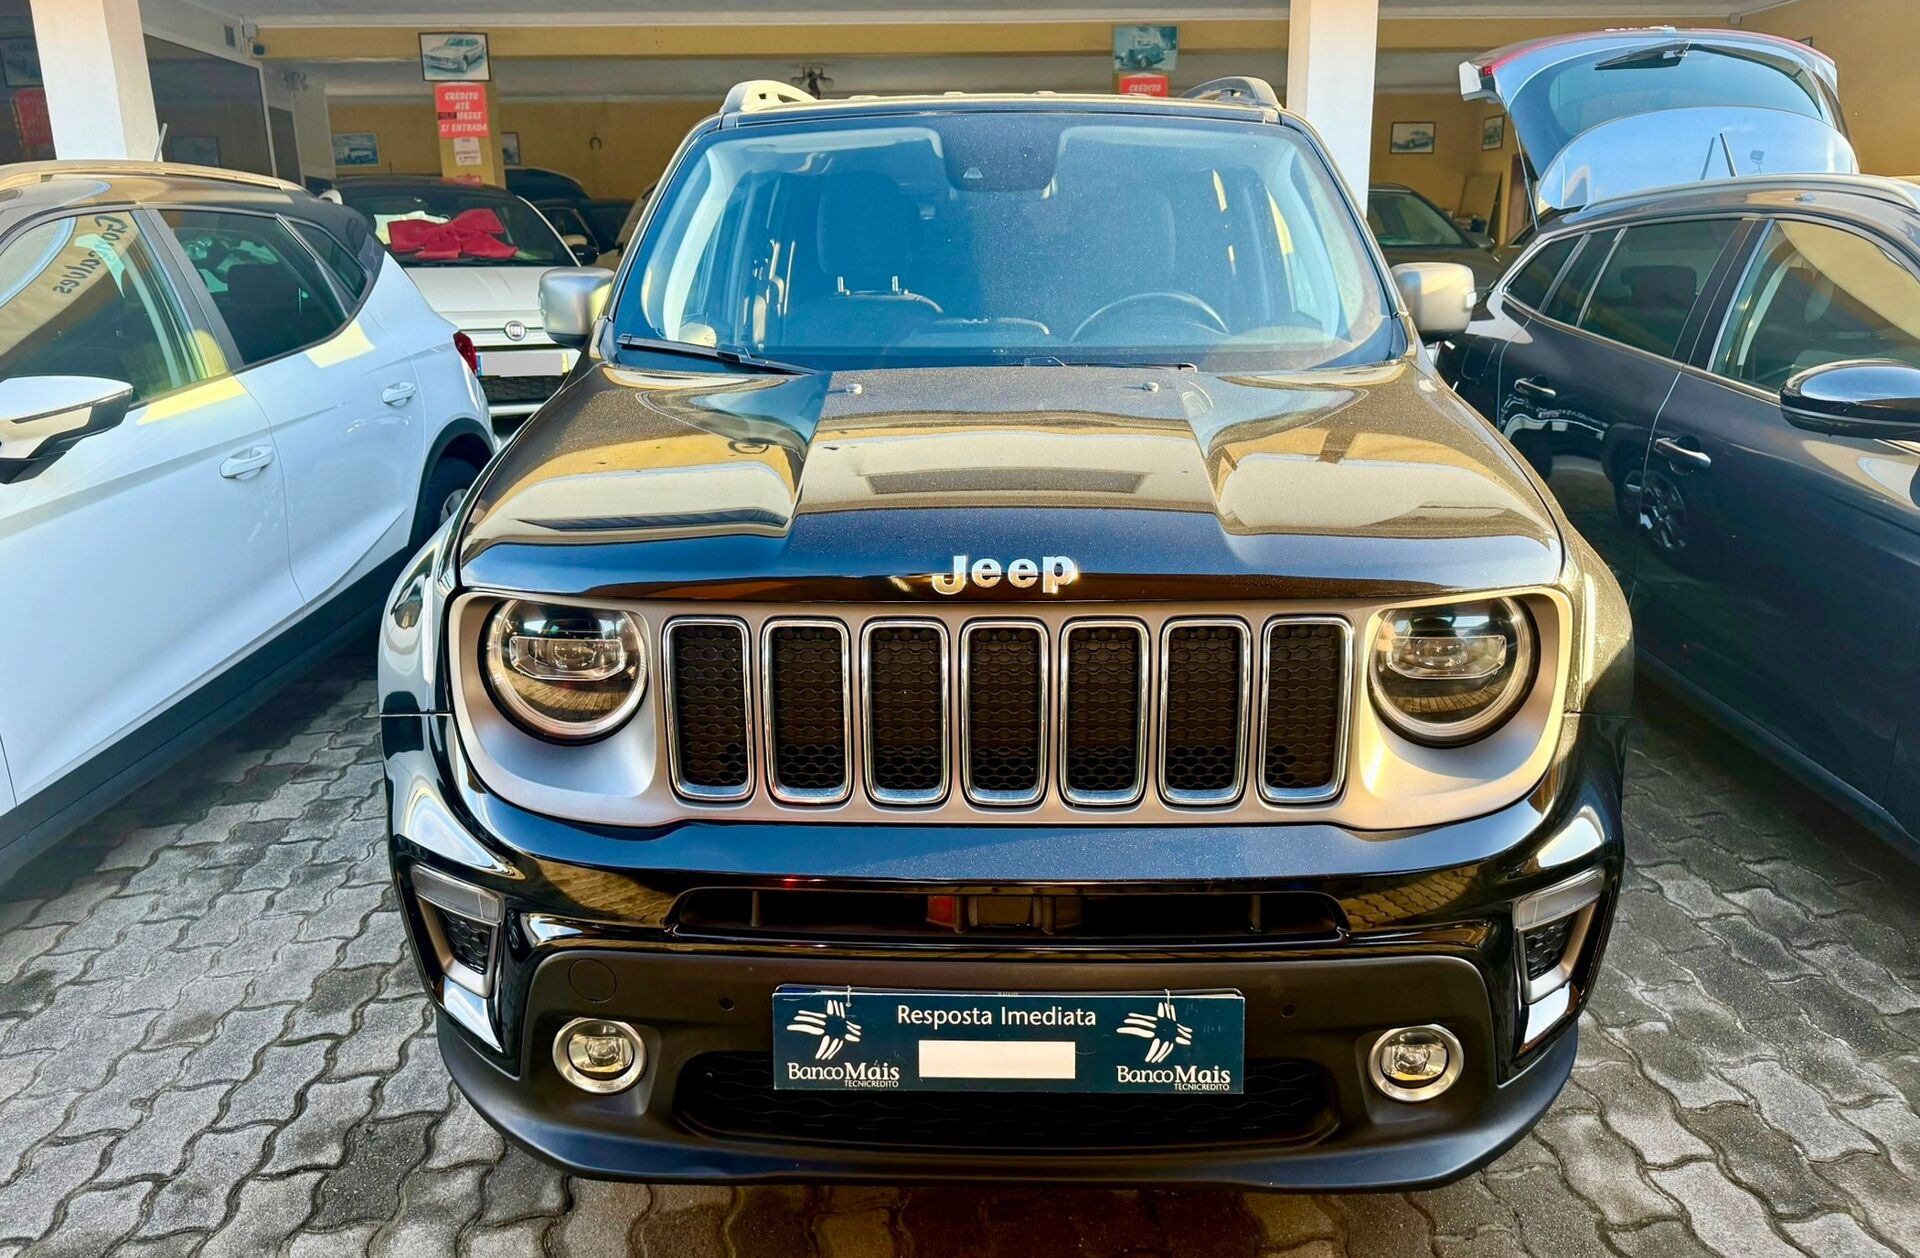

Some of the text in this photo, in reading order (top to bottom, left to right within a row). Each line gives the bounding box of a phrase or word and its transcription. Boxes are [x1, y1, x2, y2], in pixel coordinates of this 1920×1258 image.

[444, 91, 479, 100] CRÉDITO
[455, 100, 470, 110] ATÉ
[451, 123, 488, 132] ENTRADA
[931, 555, 1077, 595] Jeep
[897, 1005, 1097, 1030] Resposta Imediata
